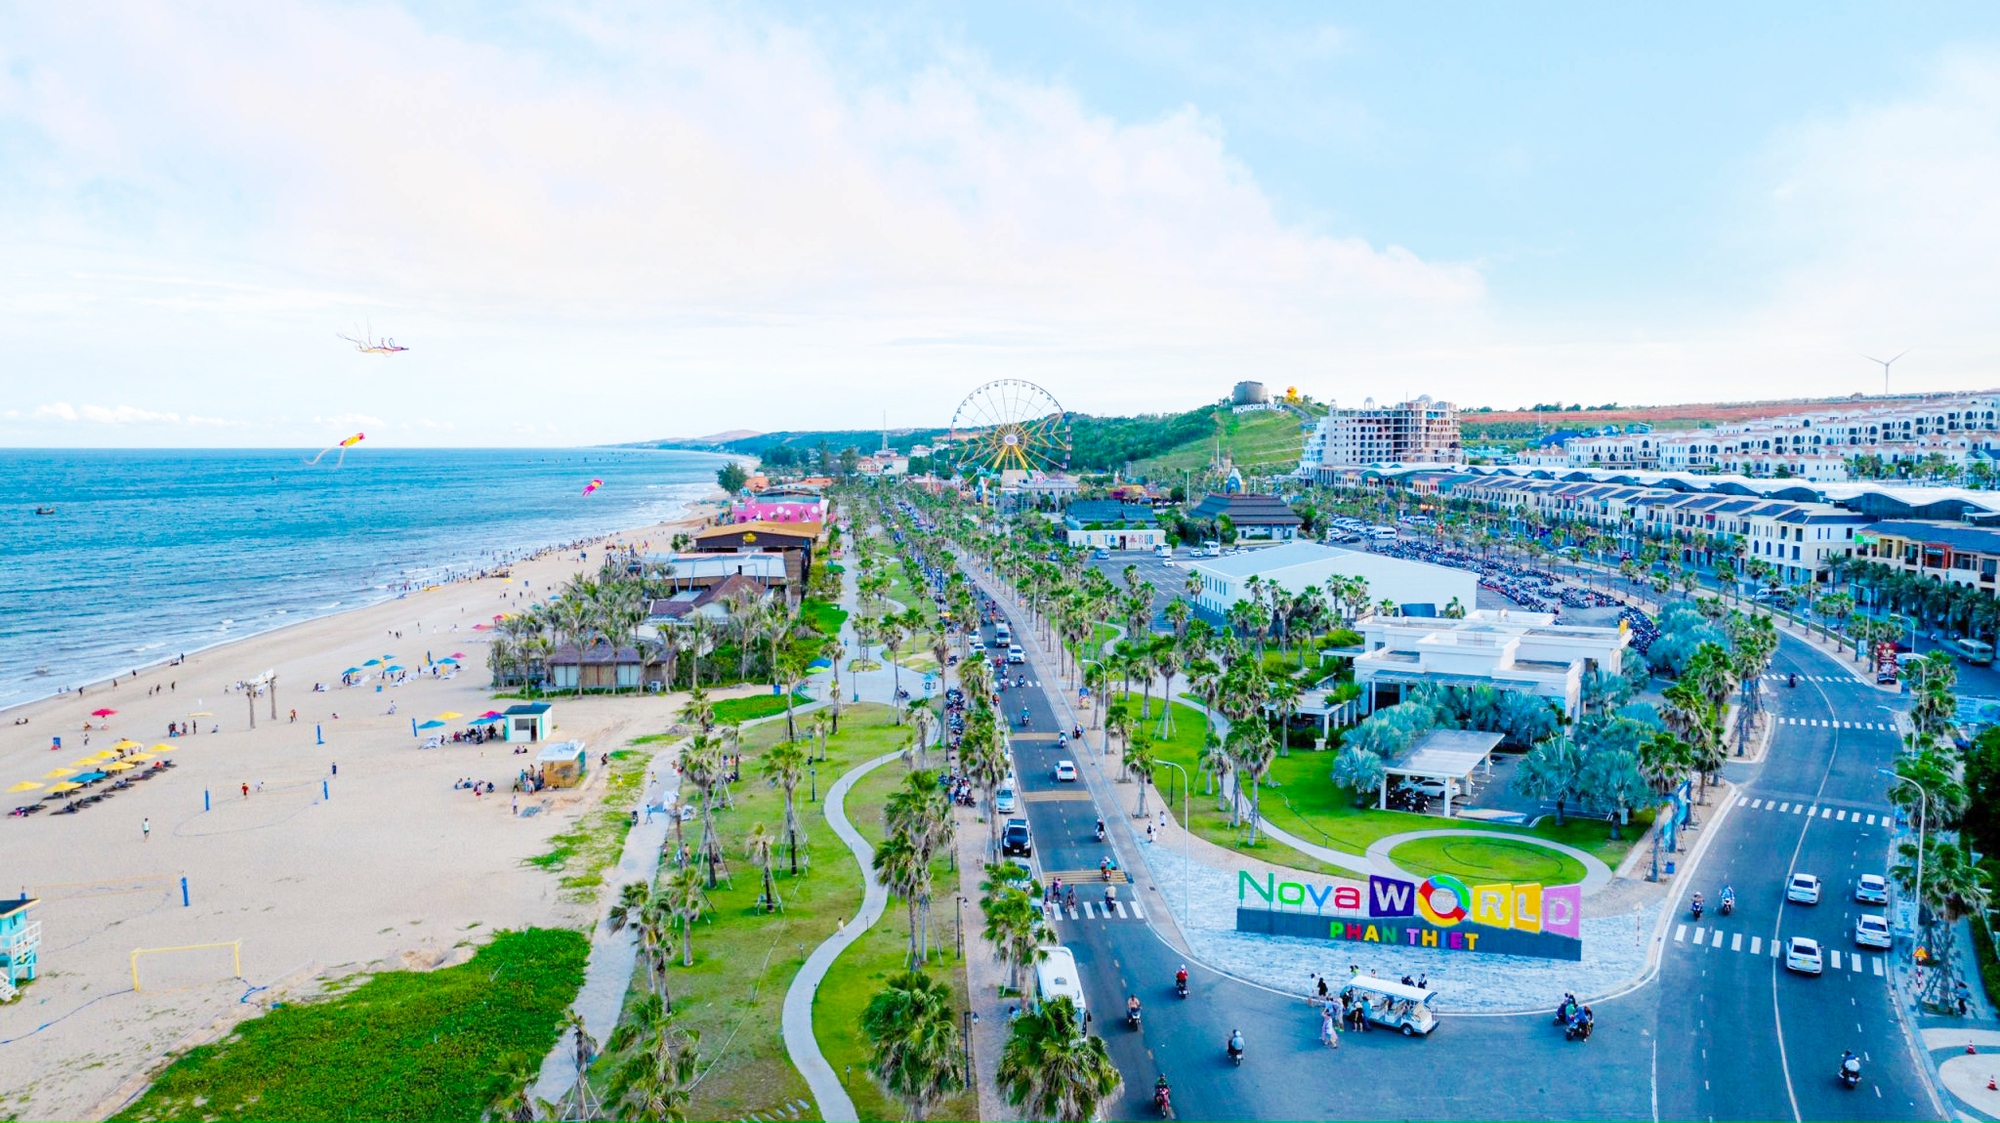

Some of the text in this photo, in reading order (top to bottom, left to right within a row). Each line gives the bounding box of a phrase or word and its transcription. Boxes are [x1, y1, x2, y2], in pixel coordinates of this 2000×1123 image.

[1232, 403, 1265, 414] WONDER
[1329, 920, 1479, 951] PHAN THIET
